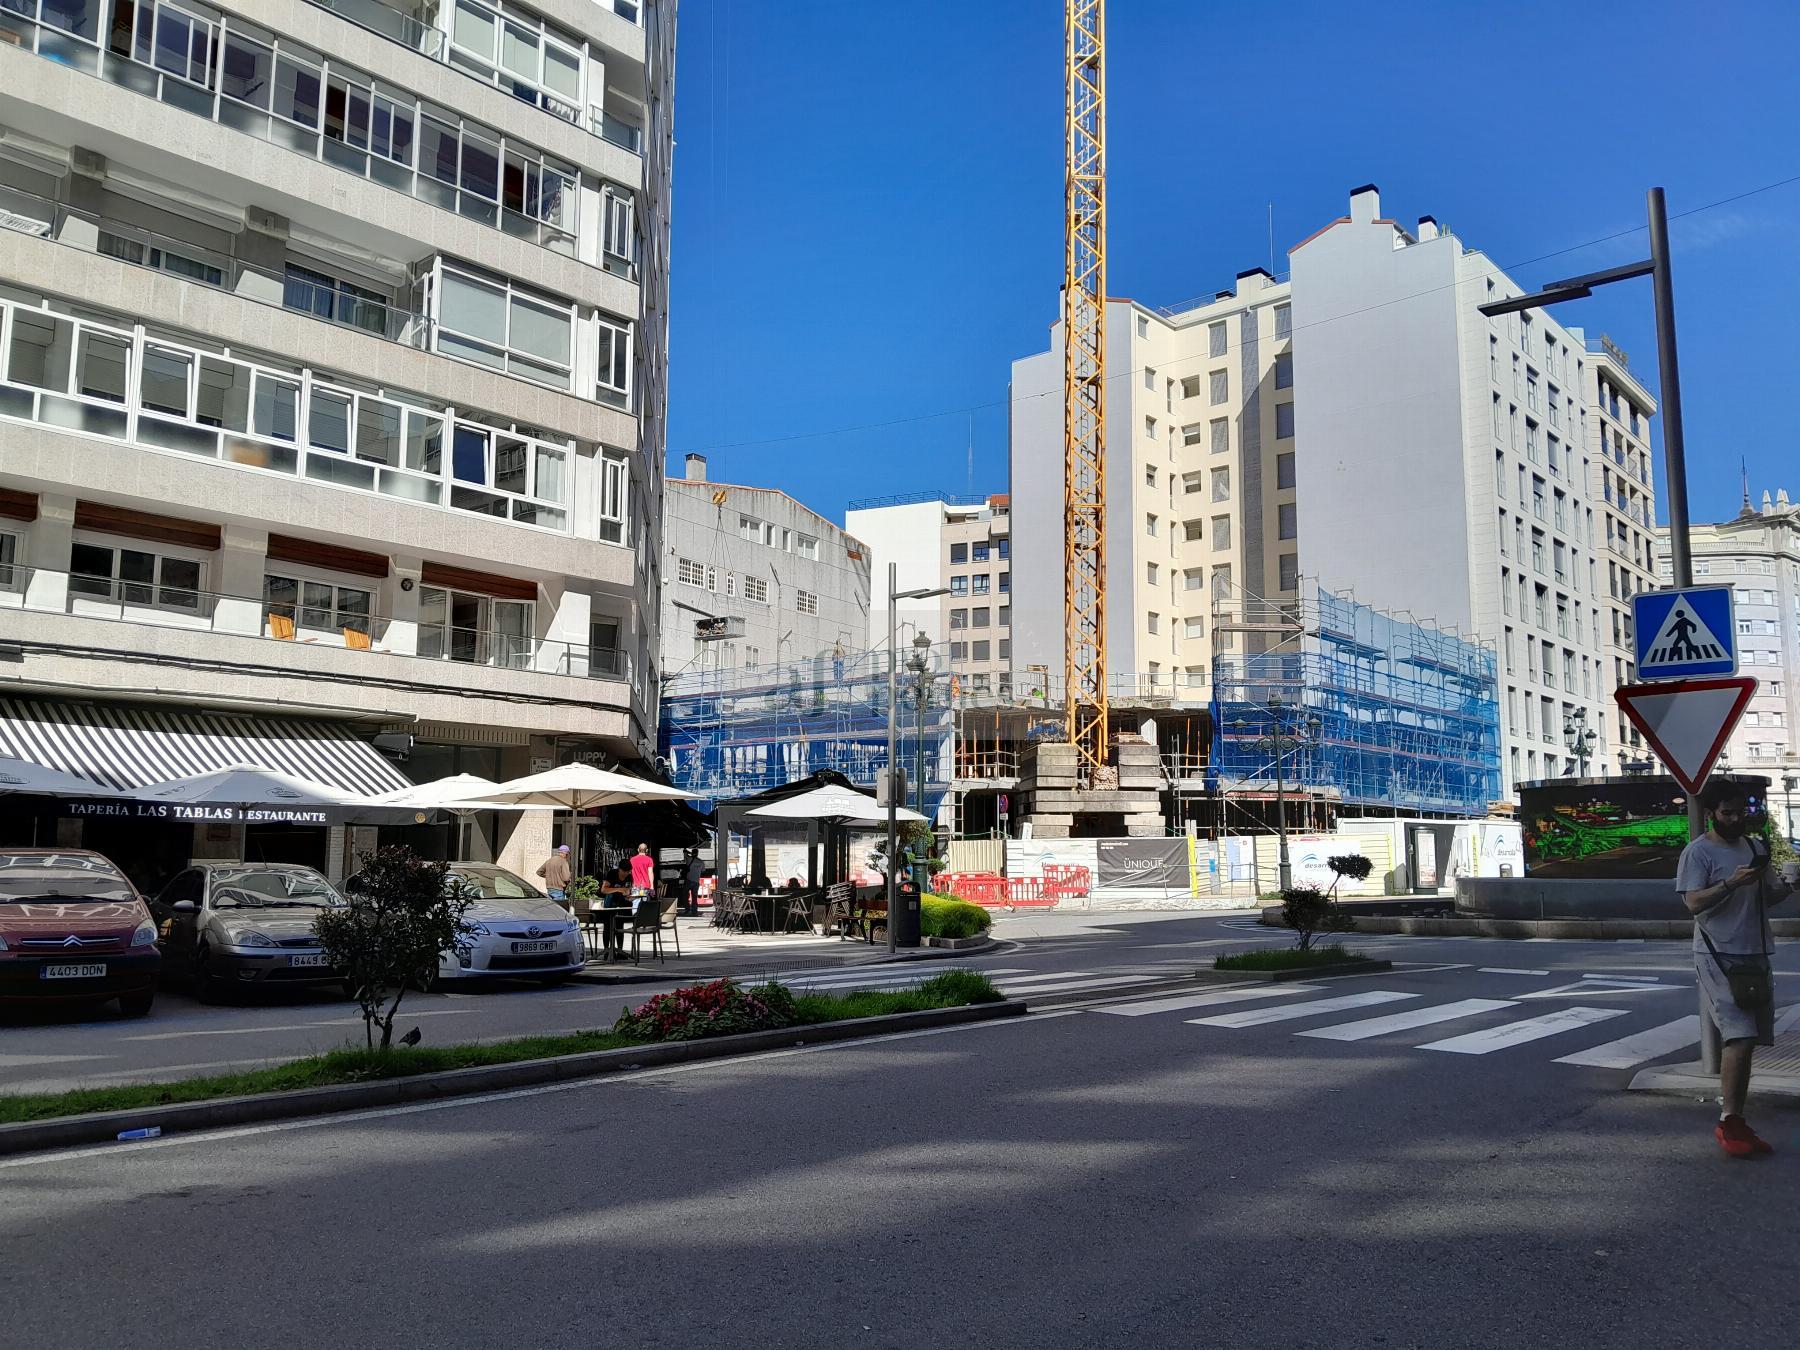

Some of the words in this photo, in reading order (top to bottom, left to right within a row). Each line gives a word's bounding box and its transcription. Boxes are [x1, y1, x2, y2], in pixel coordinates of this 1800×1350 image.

[573, 751, 607, 762] LUPPY
[69, 802, 129, 816] TAPERÍA
[137, 805, 167, 817] LAS
[173, 806, 233, 819] TABLAS
[49, 966, 78, 977] 4403
